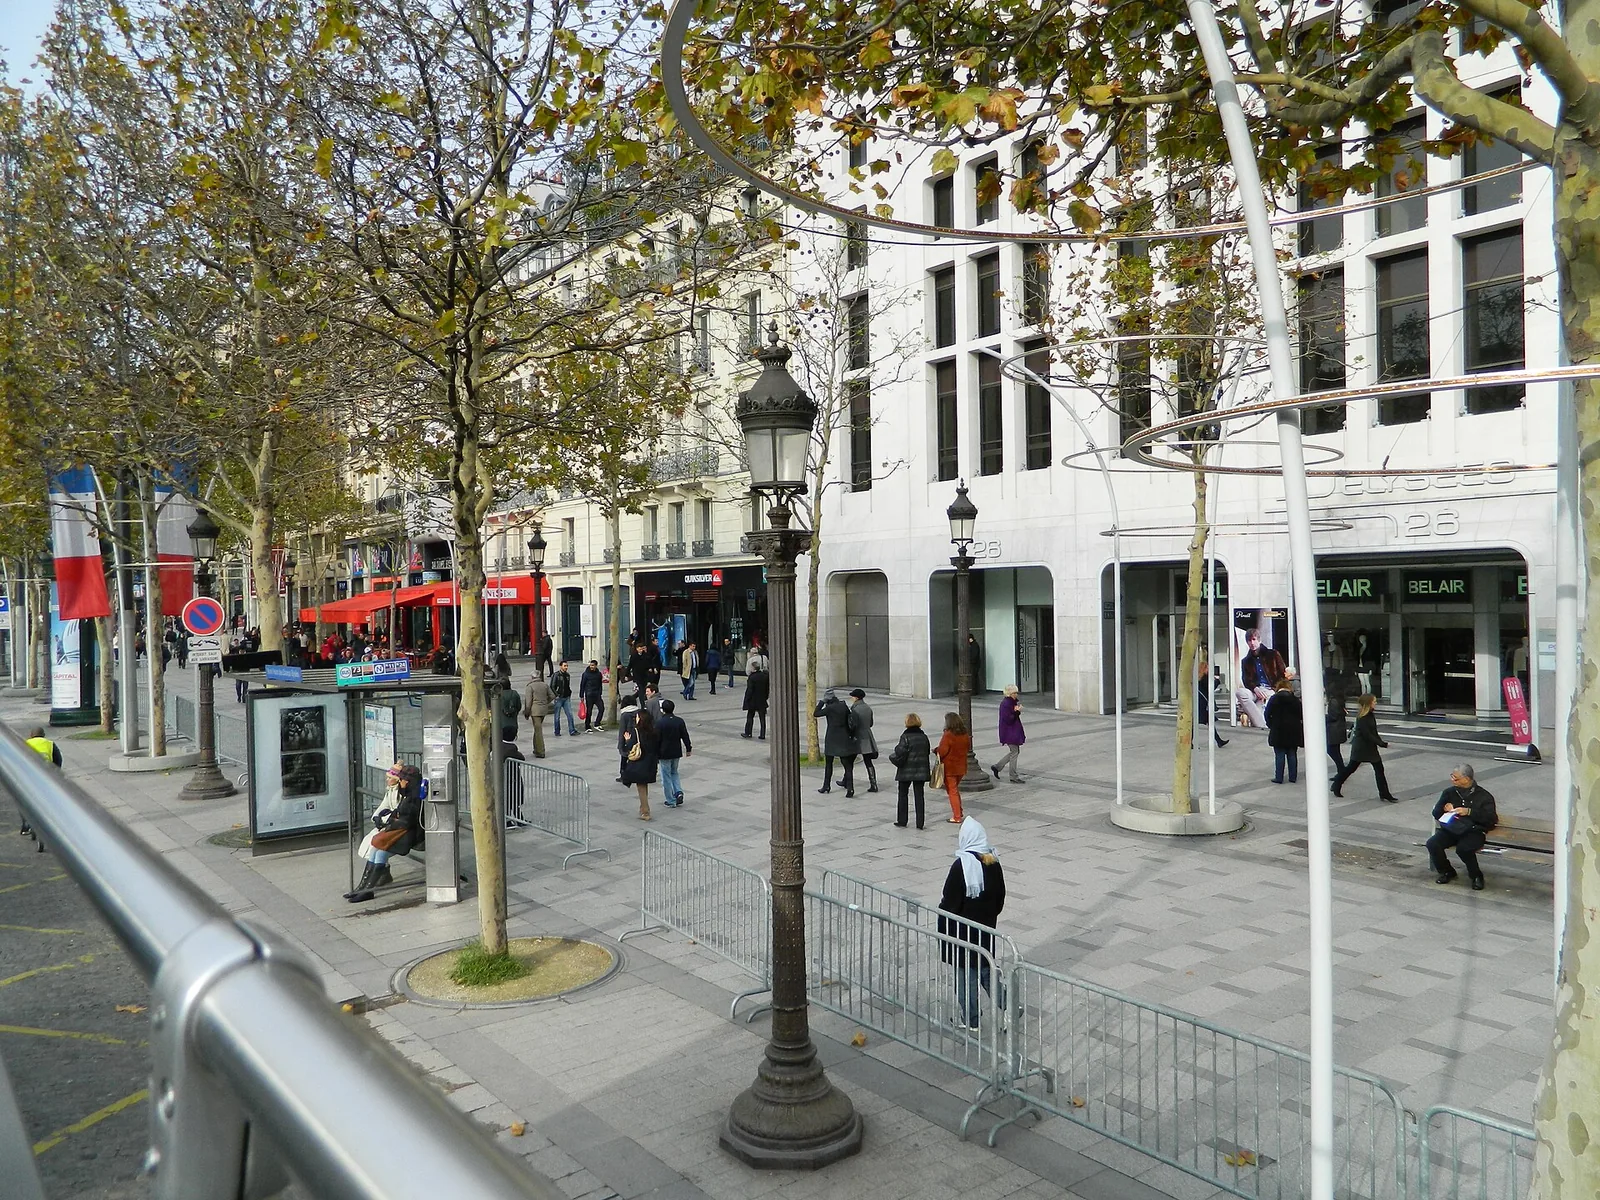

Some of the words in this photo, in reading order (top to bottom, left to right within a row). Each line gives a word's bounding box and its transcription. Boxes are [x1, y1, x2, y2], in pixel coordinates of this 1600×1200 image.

[1404, 508, 1460, 538] 26
[972, 539, 1002, 559] 26
[684, 574, 712, 583] QUIKSILVER
[1317, 578, 1372, 598] ELAIR
[1408, 579, 1465, 594] BELAIR
